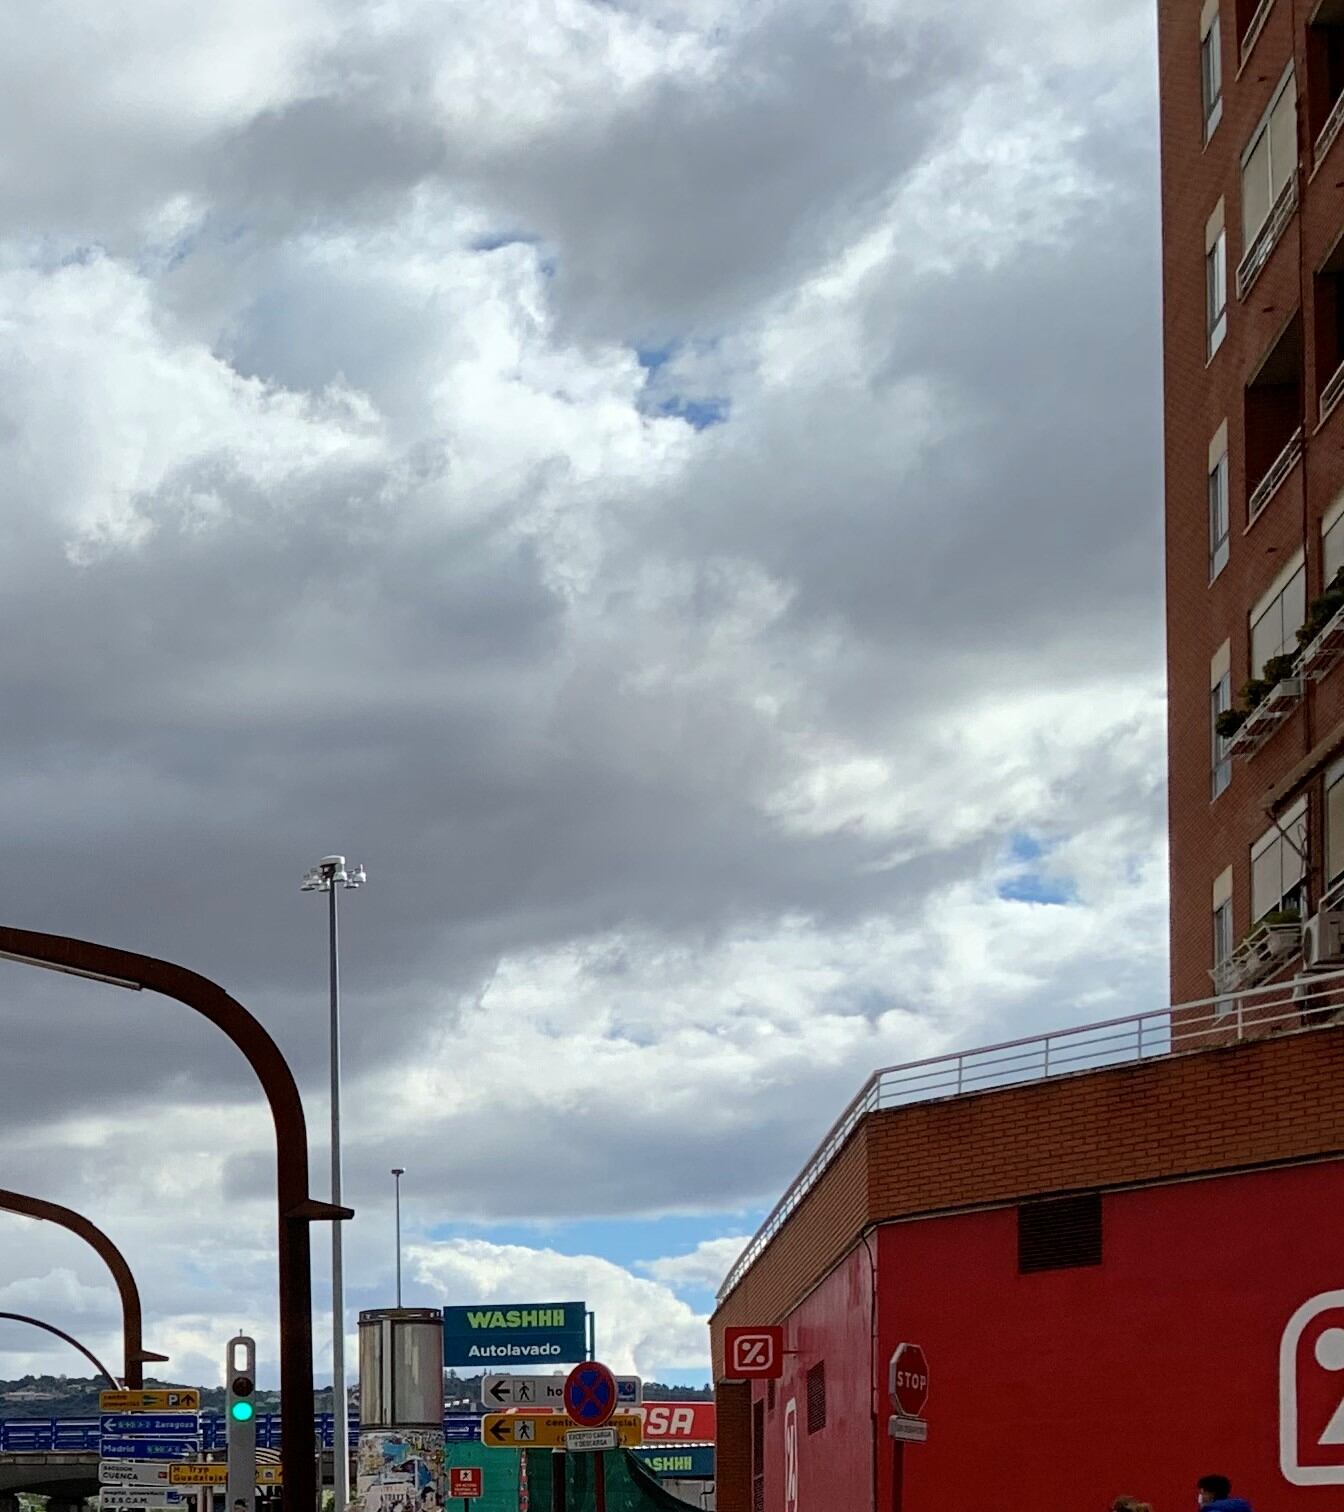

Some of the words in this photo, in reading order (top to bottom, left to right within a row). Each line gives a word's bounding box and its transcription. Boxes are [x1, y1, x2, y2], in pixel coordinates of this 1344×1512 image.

[467, 1308, 565, 1329] WASHHH
[468, 1342, 561, 1357] Autolavado
[897, 1371, 927, 1391] STOP
[155, 1420, 194, 1430] Zaragoza
[103, 1444, 135, 1453] Madrid
[102, 1471, 138, 1480] CUENCA
